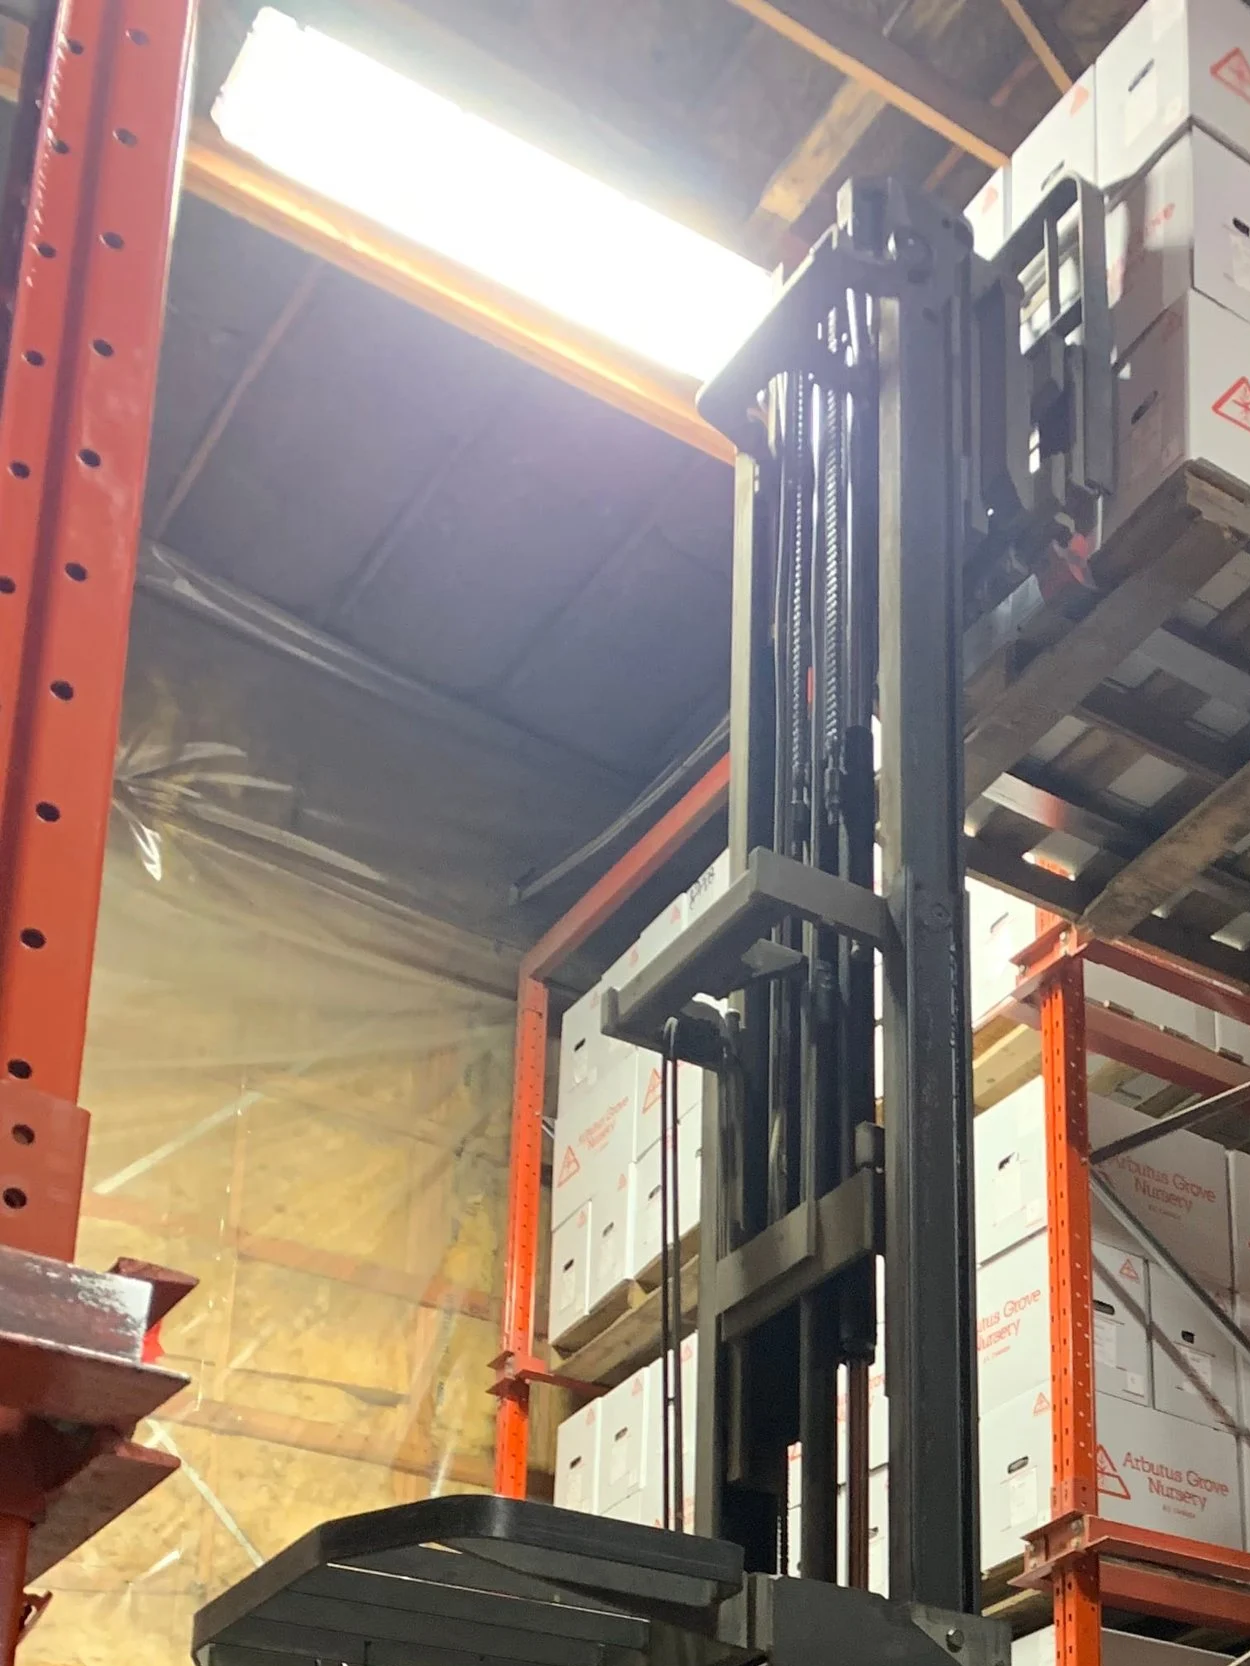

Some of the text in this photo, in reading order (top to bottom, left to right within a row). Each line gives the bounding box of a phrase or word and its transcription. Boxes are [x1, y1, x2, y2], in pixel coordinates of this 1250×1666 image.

[1133, 1175, 1192, 1212] Nursery
[1172, 1173, 1216, 1203] Grove
[1003, 1289, 1042, 1318] Grove
[1122, 1452, 1230, 1497] Arbutus Grove
[1147, 1477, 1208, 1513] Nursery
